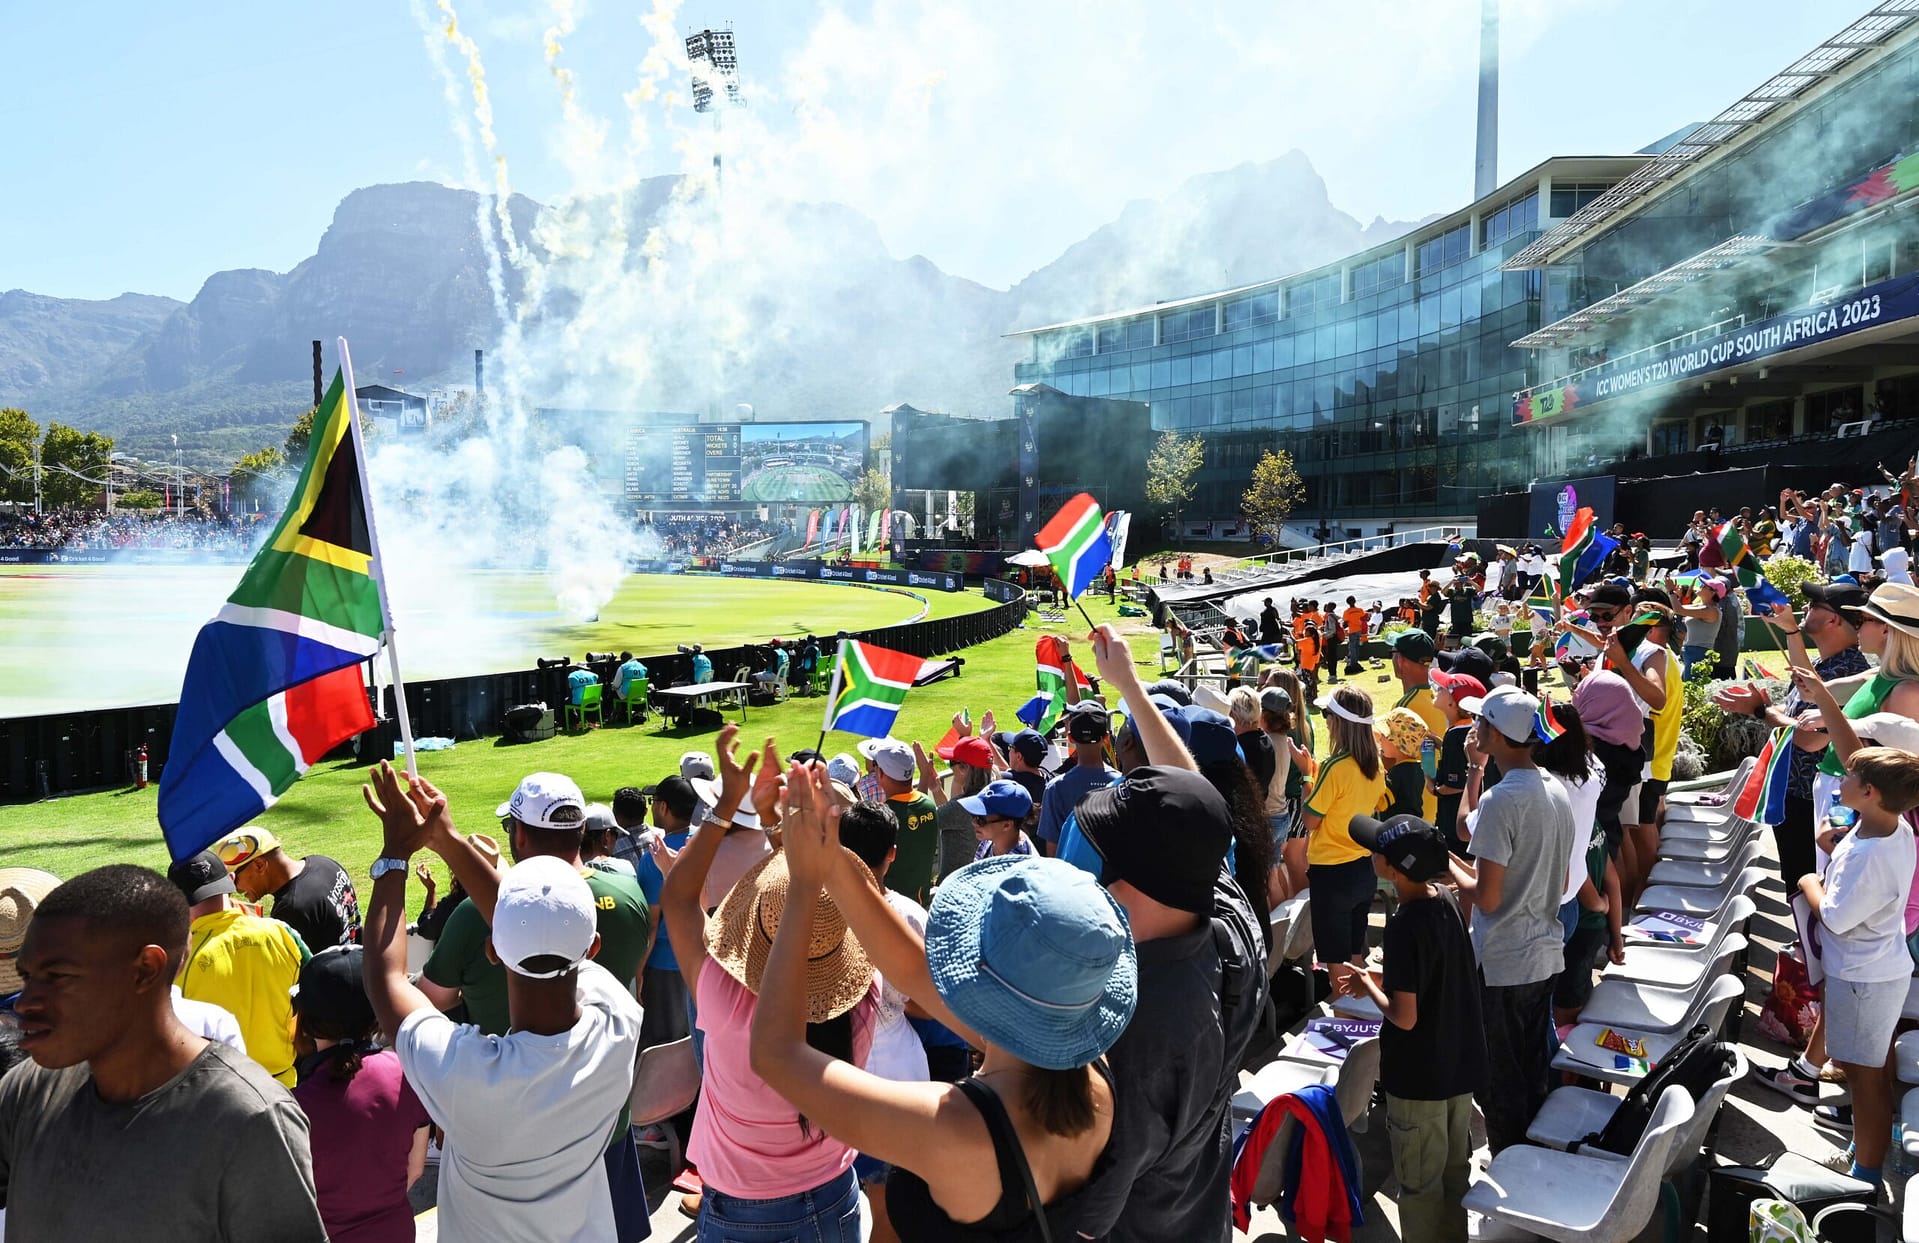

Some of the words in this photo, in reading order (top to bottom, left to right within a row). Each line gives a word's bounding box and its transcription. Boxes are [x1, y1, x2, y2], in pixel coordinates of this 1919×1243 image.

[1596, 378, 1608, 397] ICC
[1610, 366, 1651, 393] WOMEN'S
[1652, 360, 1668, 381] T20
[1669, 348, 1709, 376] WORLD
[1710, 340, 1734, 364] CUP
[1736, 325, 1780, 357] SOUTH
[1783, 308, 1838, 344] AFRICA
[1841, 294, 1881, 328] 2023
[919, 811, 934, 824] FNB
[1378, 820, 1411, 848] SOVIET
[1333, 1024, 1381, 1033] BYJU'S
